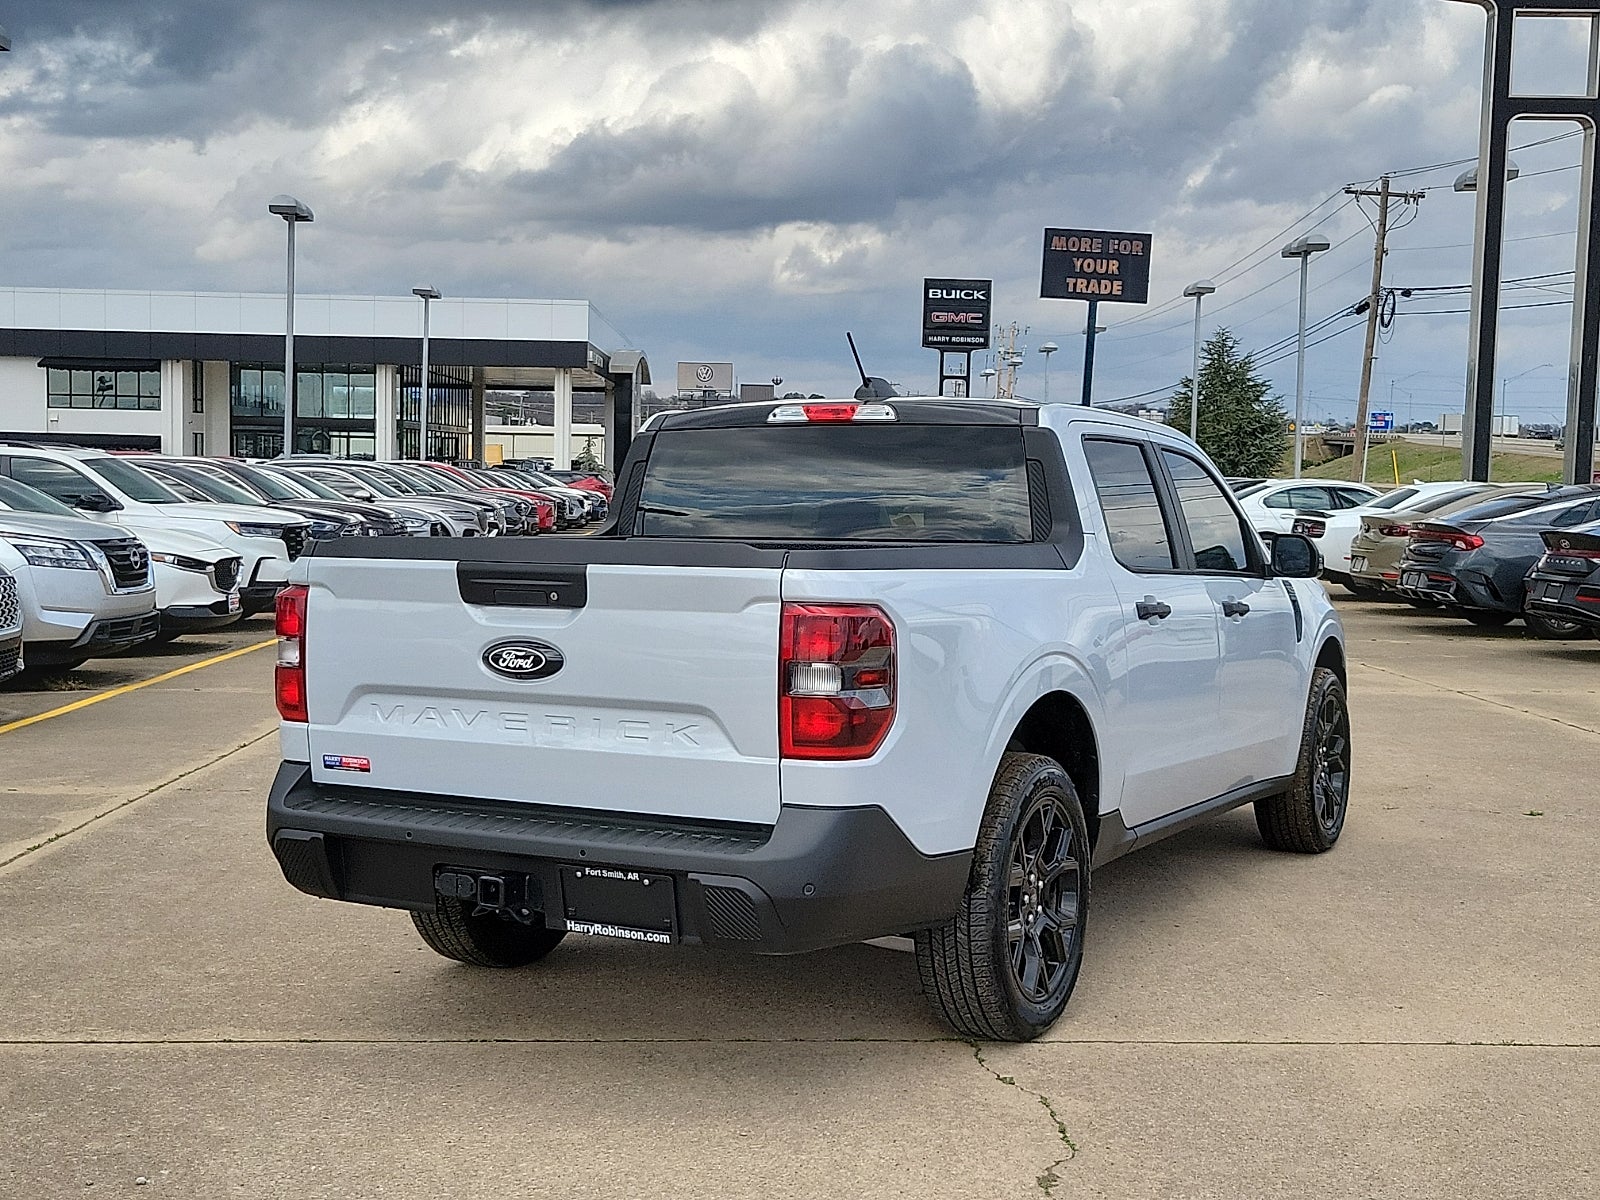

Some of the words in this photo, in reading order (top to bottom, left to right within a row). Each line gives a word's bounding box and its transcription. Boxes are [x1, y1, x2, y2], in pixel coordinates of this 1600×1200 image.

[1050, 235, 1102, 253] MORE
[1108, 239, 1144, 255] FOR
[1072, 258, 1120, 275] YOUR
[928, 289, 987, 300] BUICK
[1066, 277, 1123, 295] TRADE
[931, 311, 983, 324] GMC
[928, 335, 949, 343] HARRY
[951, 336, 985, 344] ROBINSON
[498, 649, 534, 670] Ford
[370, 703, 702, 747] MAVERICK
[585, 867, 602, 877] Fort
[602, 869, 627, 880] Smith,
[627, 872, 640, 881] AR
[566, 920, 671, 944] HarryRobinson.com
